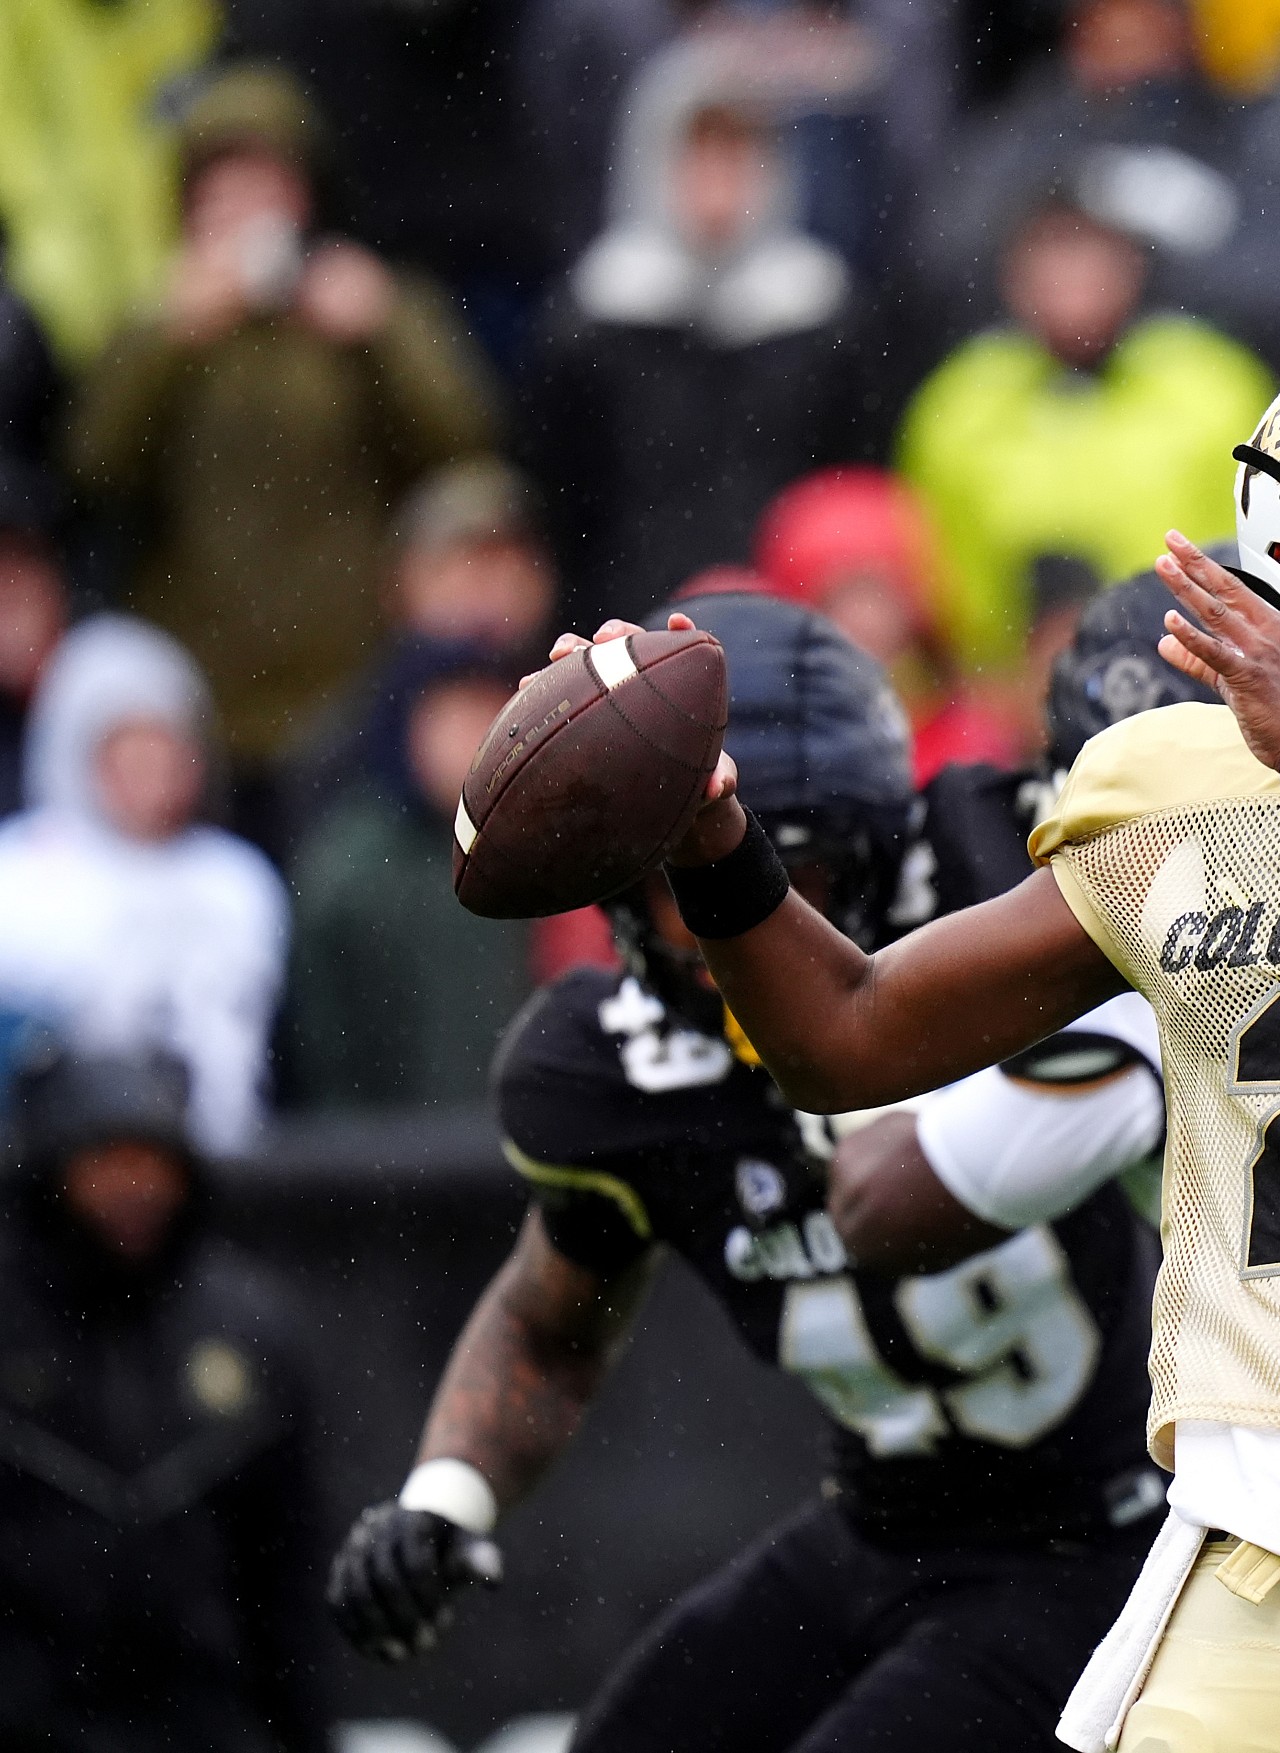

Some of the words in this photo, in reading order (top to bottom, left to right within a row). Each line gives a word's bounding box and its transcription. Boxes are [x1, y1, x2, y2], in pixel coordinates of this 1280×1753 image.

[485, 741, 525, 794] VAPOR
[524, 699, 571, 744] ELITE
[779, 1224, 1100, 1457] 19
